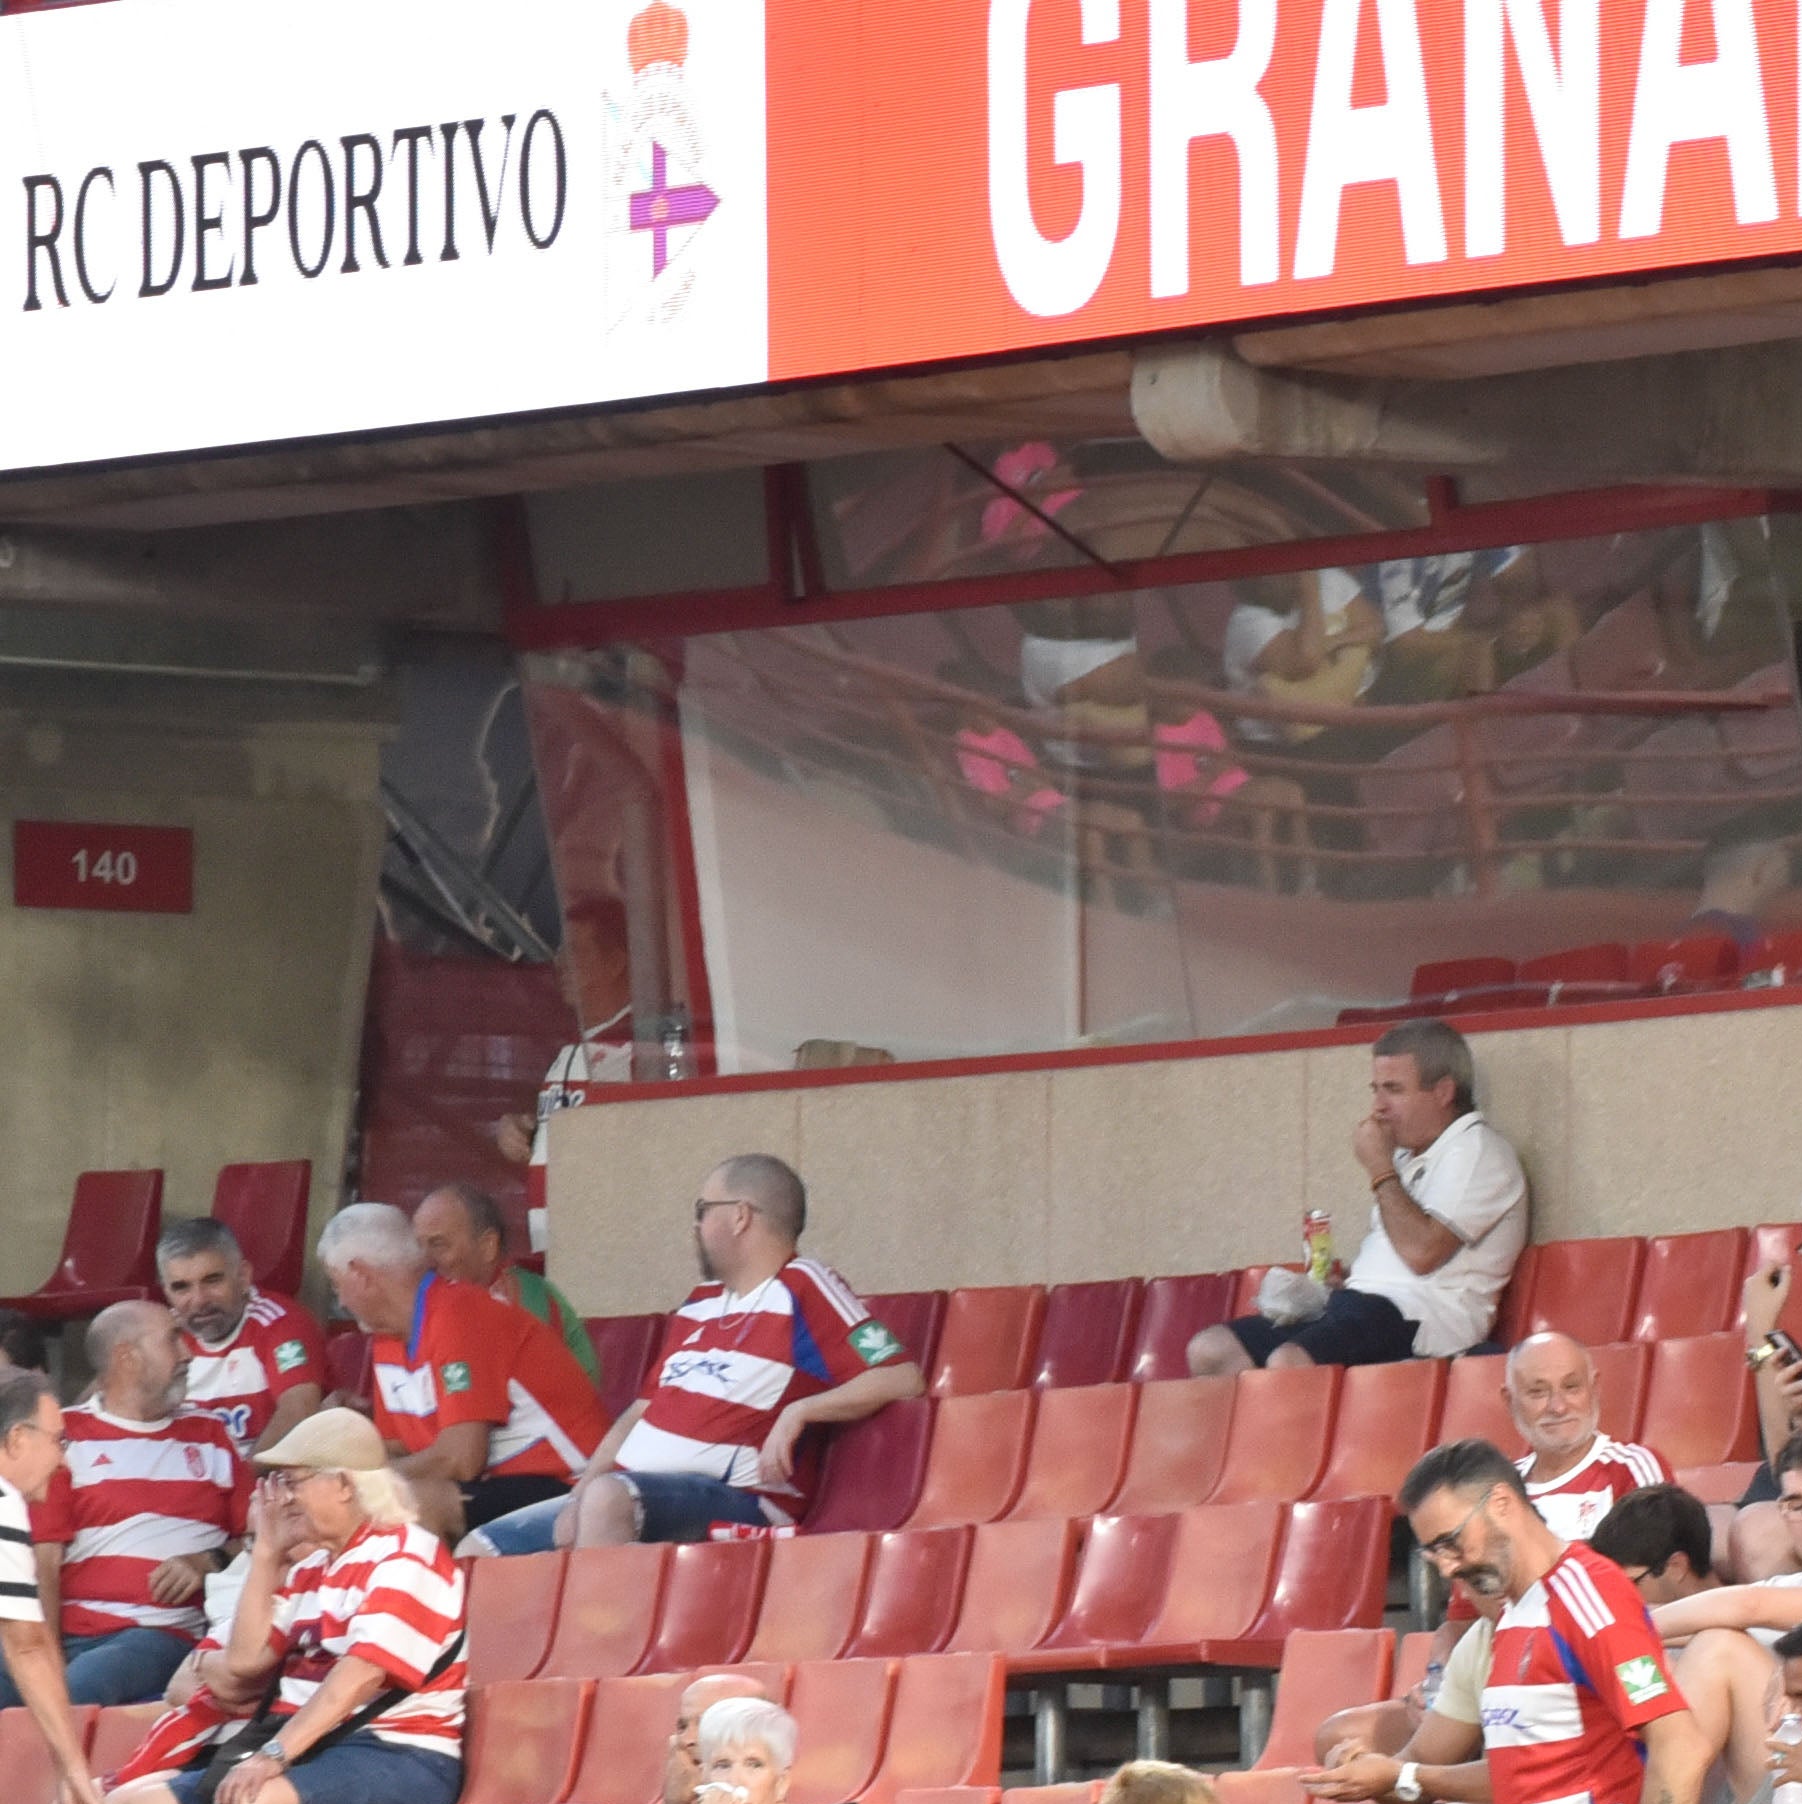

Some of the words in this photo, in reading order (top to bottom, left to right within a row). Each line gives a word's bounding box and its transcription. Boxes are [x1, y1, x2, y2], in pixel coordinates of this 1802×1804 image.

[23, 166, 117, 311] RC
[138, 108, 568, 298] DEPORTIVO
[71, 848, 137, 887] 140
